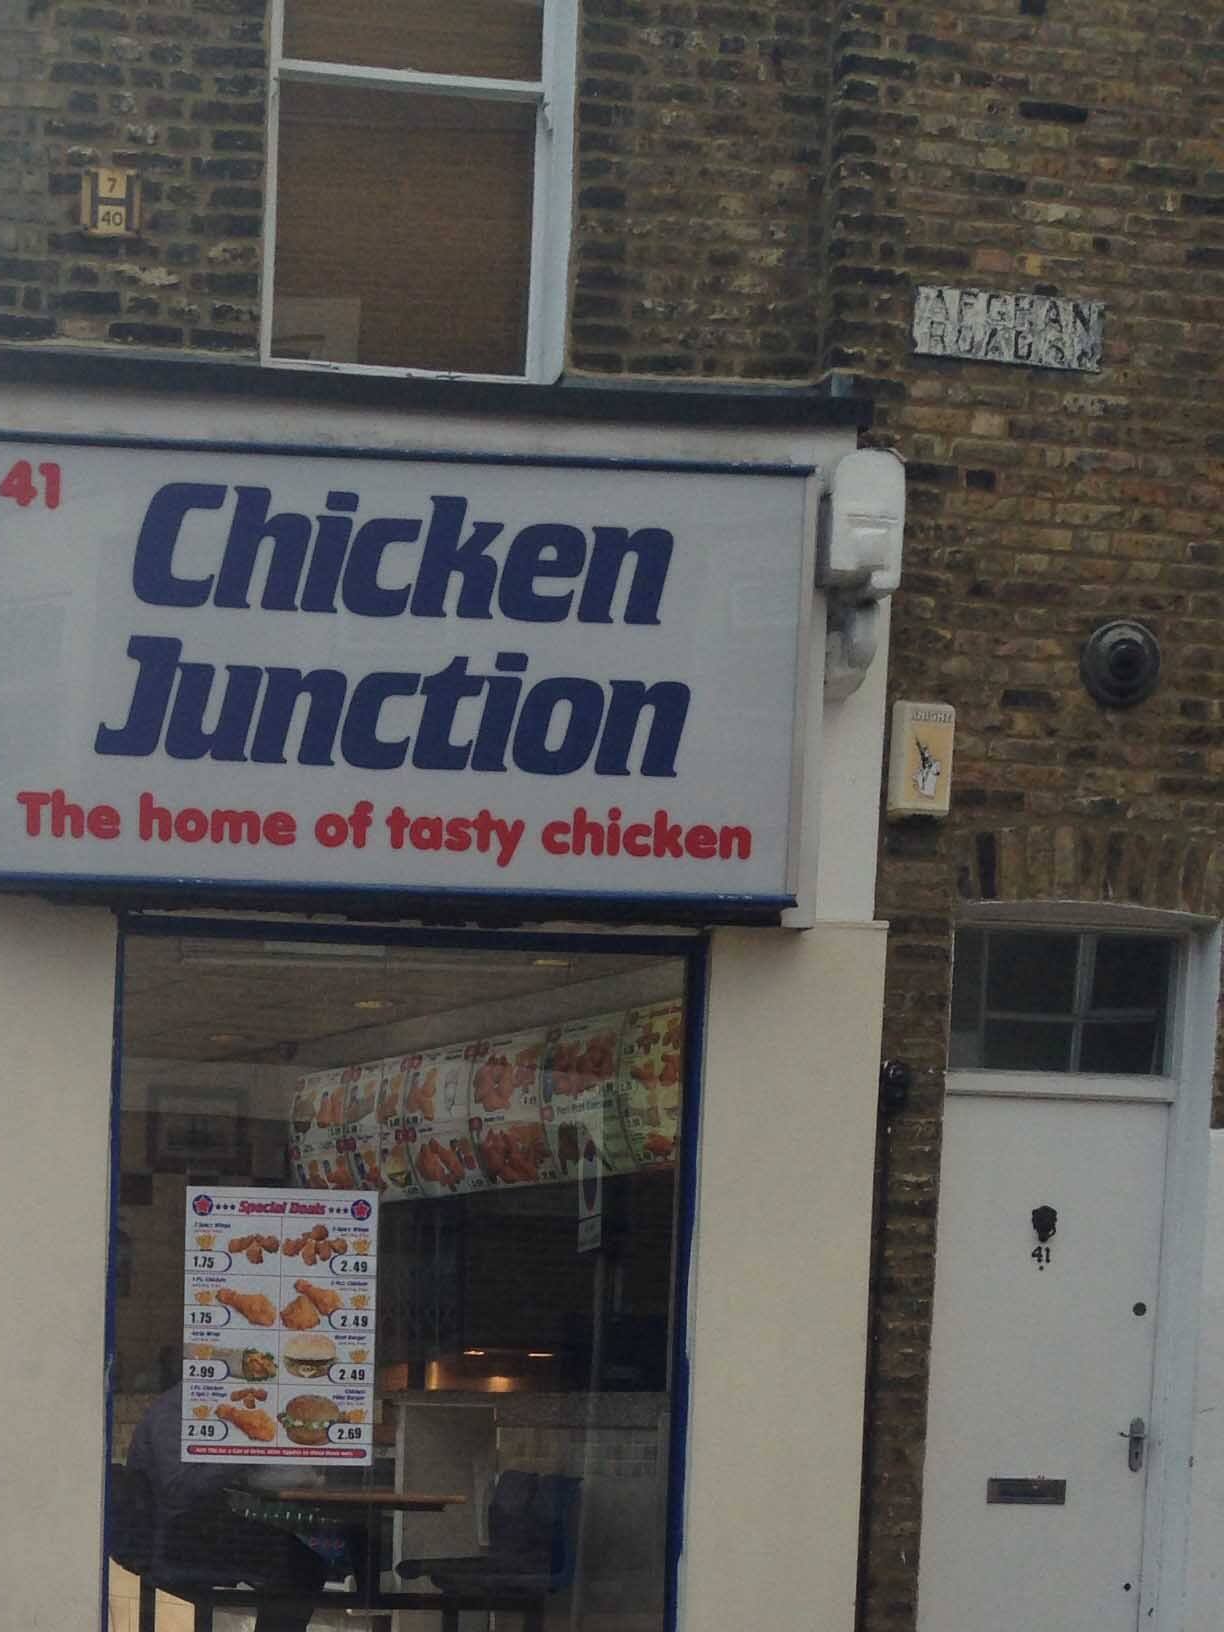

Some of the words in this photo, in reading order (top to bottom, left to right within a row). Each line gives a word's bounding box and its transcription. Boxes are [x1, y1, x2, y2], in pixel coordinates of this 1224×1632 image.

[106, 176, 118, 194] 7
[101, 211, 123, 227] 40
[132, 482, 674, 625] Chicken
[95, 635, 690, 778] Junction
[17, 790, 121, 840] The
[139, 793, 296, 846] home
[314, 800, 374, 849] of
[386, 806, 525, 868] tasty
[542, 807, 751, 860] chicken
[238, 1200, 286, 1216] Special
[193, 1255, 215, 1269] 1.75
[1031, 1246, 1051, 1264] 41
[340, 1260, 368, 1273] 2.49
[191, 1311, 213, 1325] 1.75
[340, 1315, 368, 1328] 2.49
[189, 1365, 215, 1378] 2.99
[338, 1369, 366, 1381] 2.49
[187, 1425, 215, 1437] 2.49
[337, 1427, 362, 1440] 2.69
